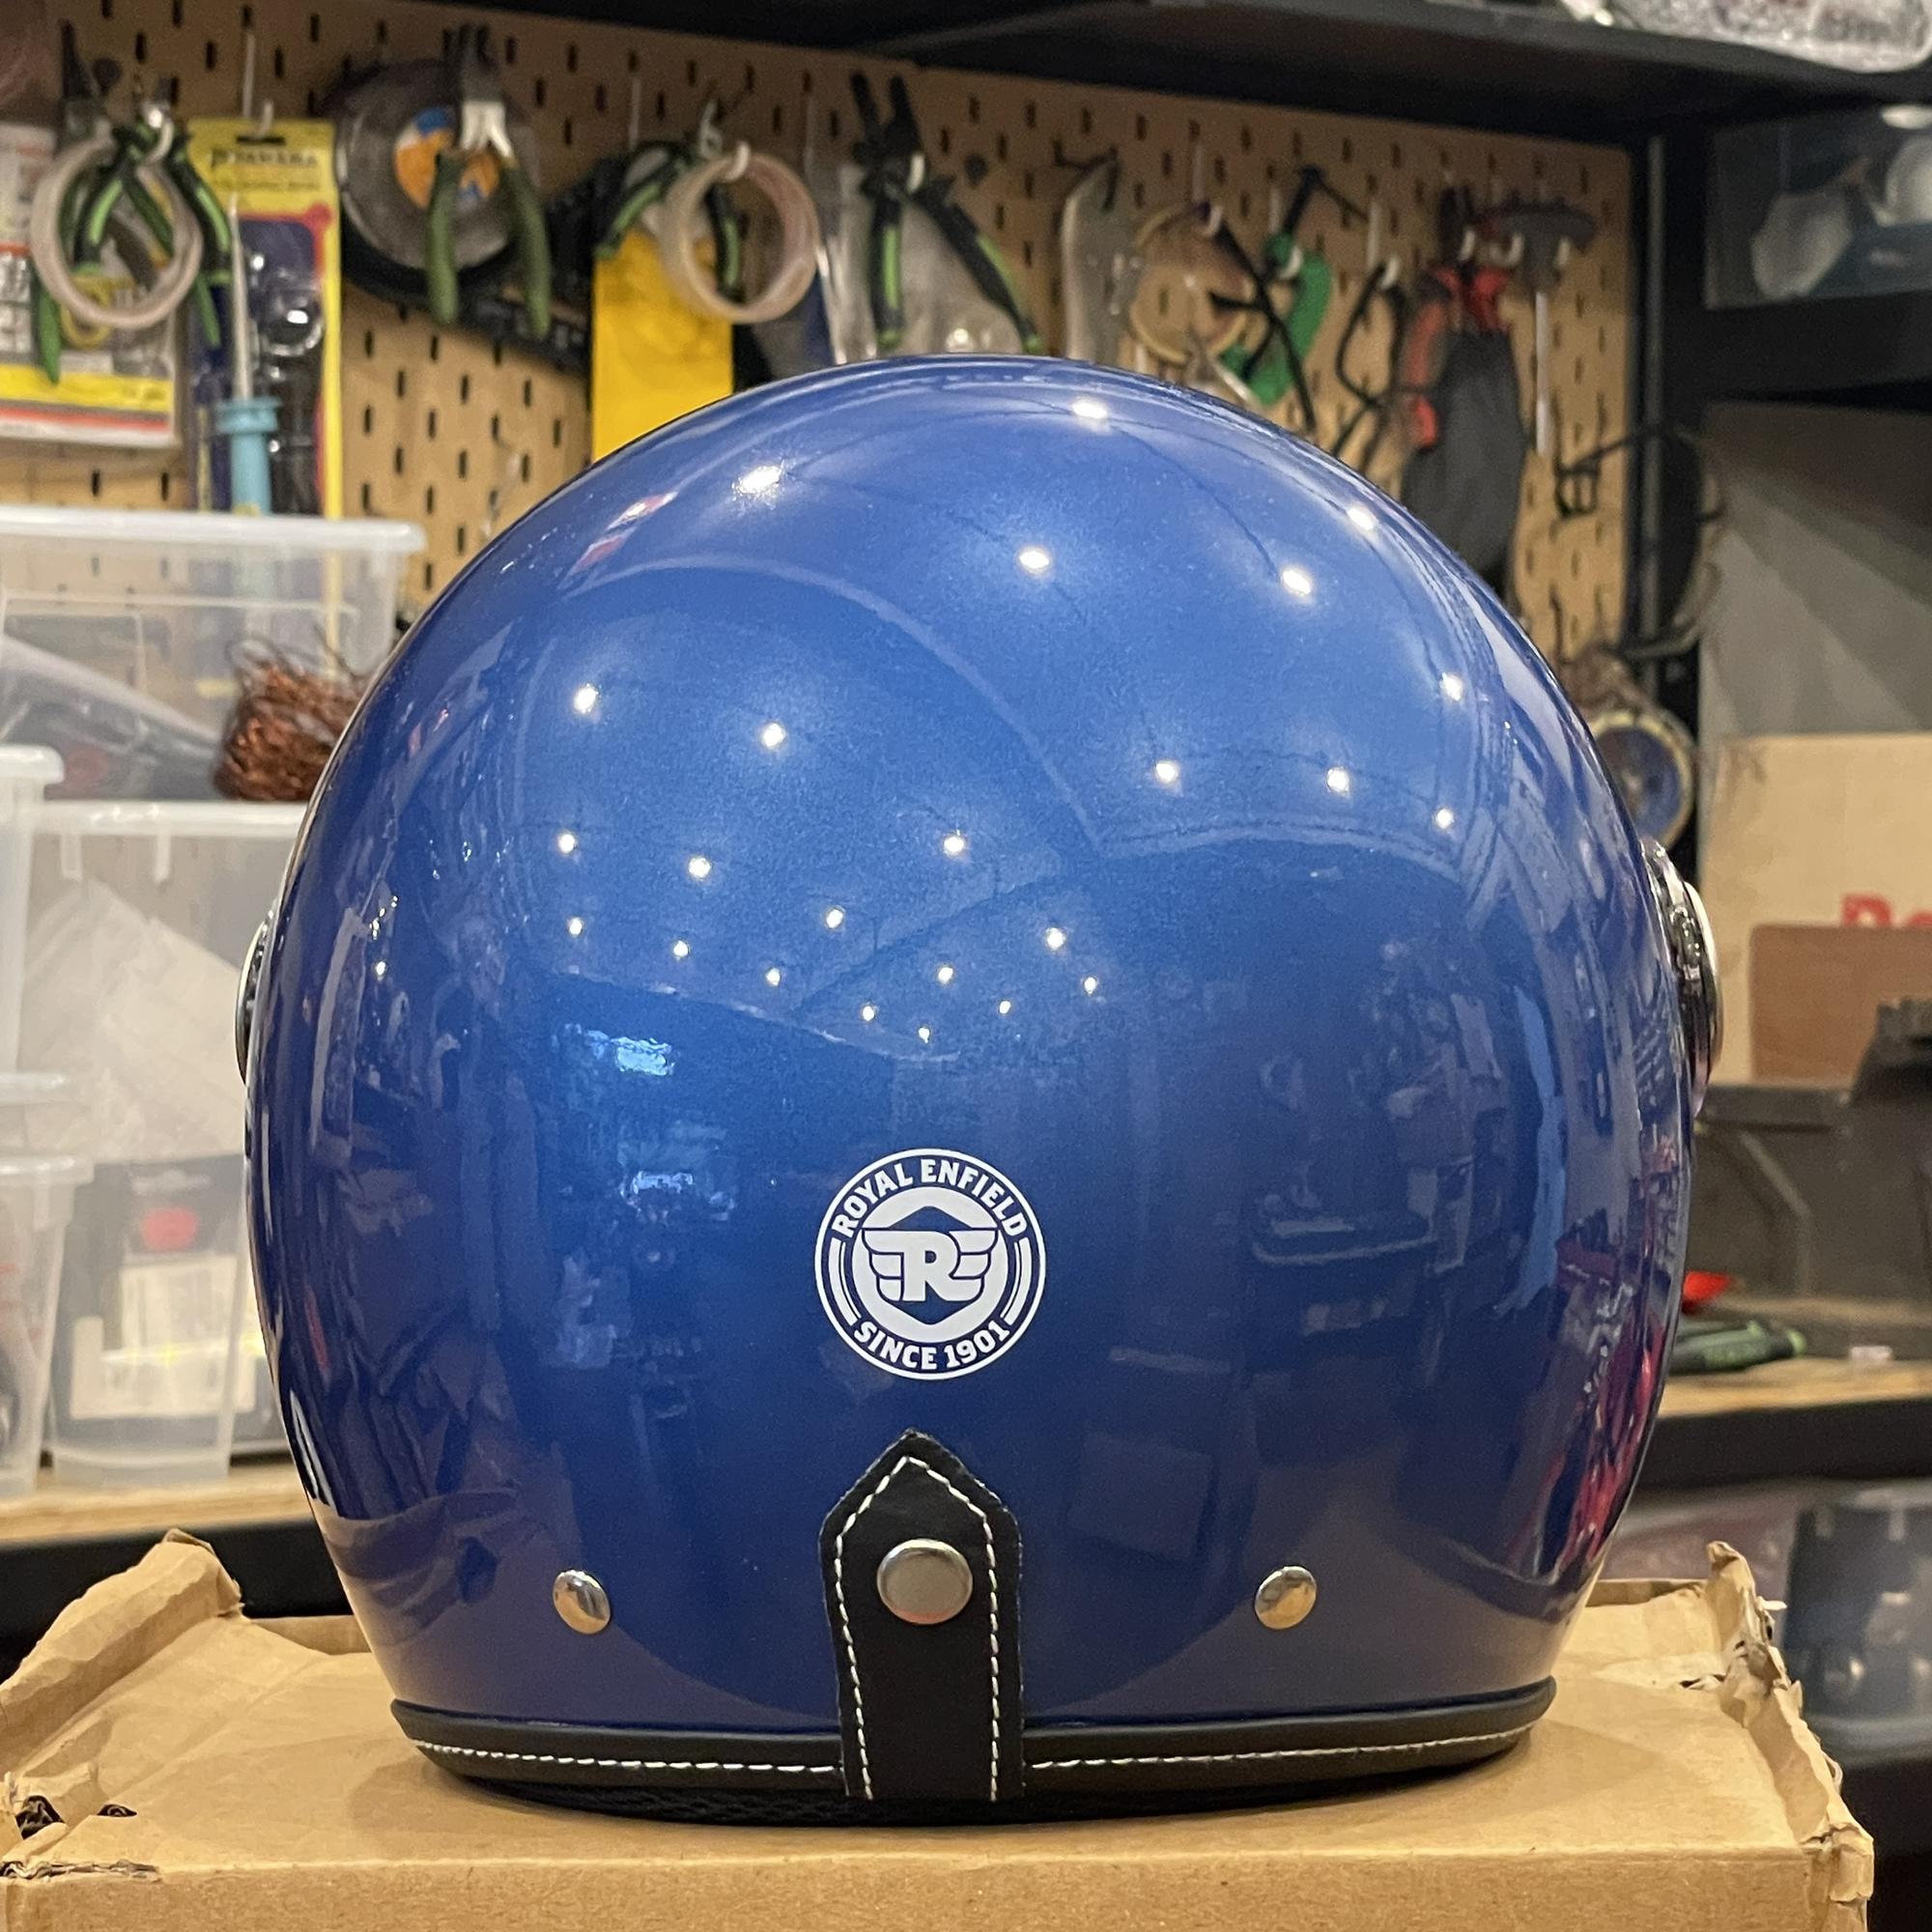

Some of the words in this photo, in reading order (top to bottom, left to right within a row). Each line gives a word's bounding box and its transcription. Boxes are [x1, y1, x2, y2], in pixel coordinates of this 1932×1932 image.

[832, 1163, 913, 1237] ROYAL
[921, 1159, 1028, 1236] ENFIELD
[854, 1321, 937, 1370] SINCE
[944, 1320, 1009, 1368] 1901
